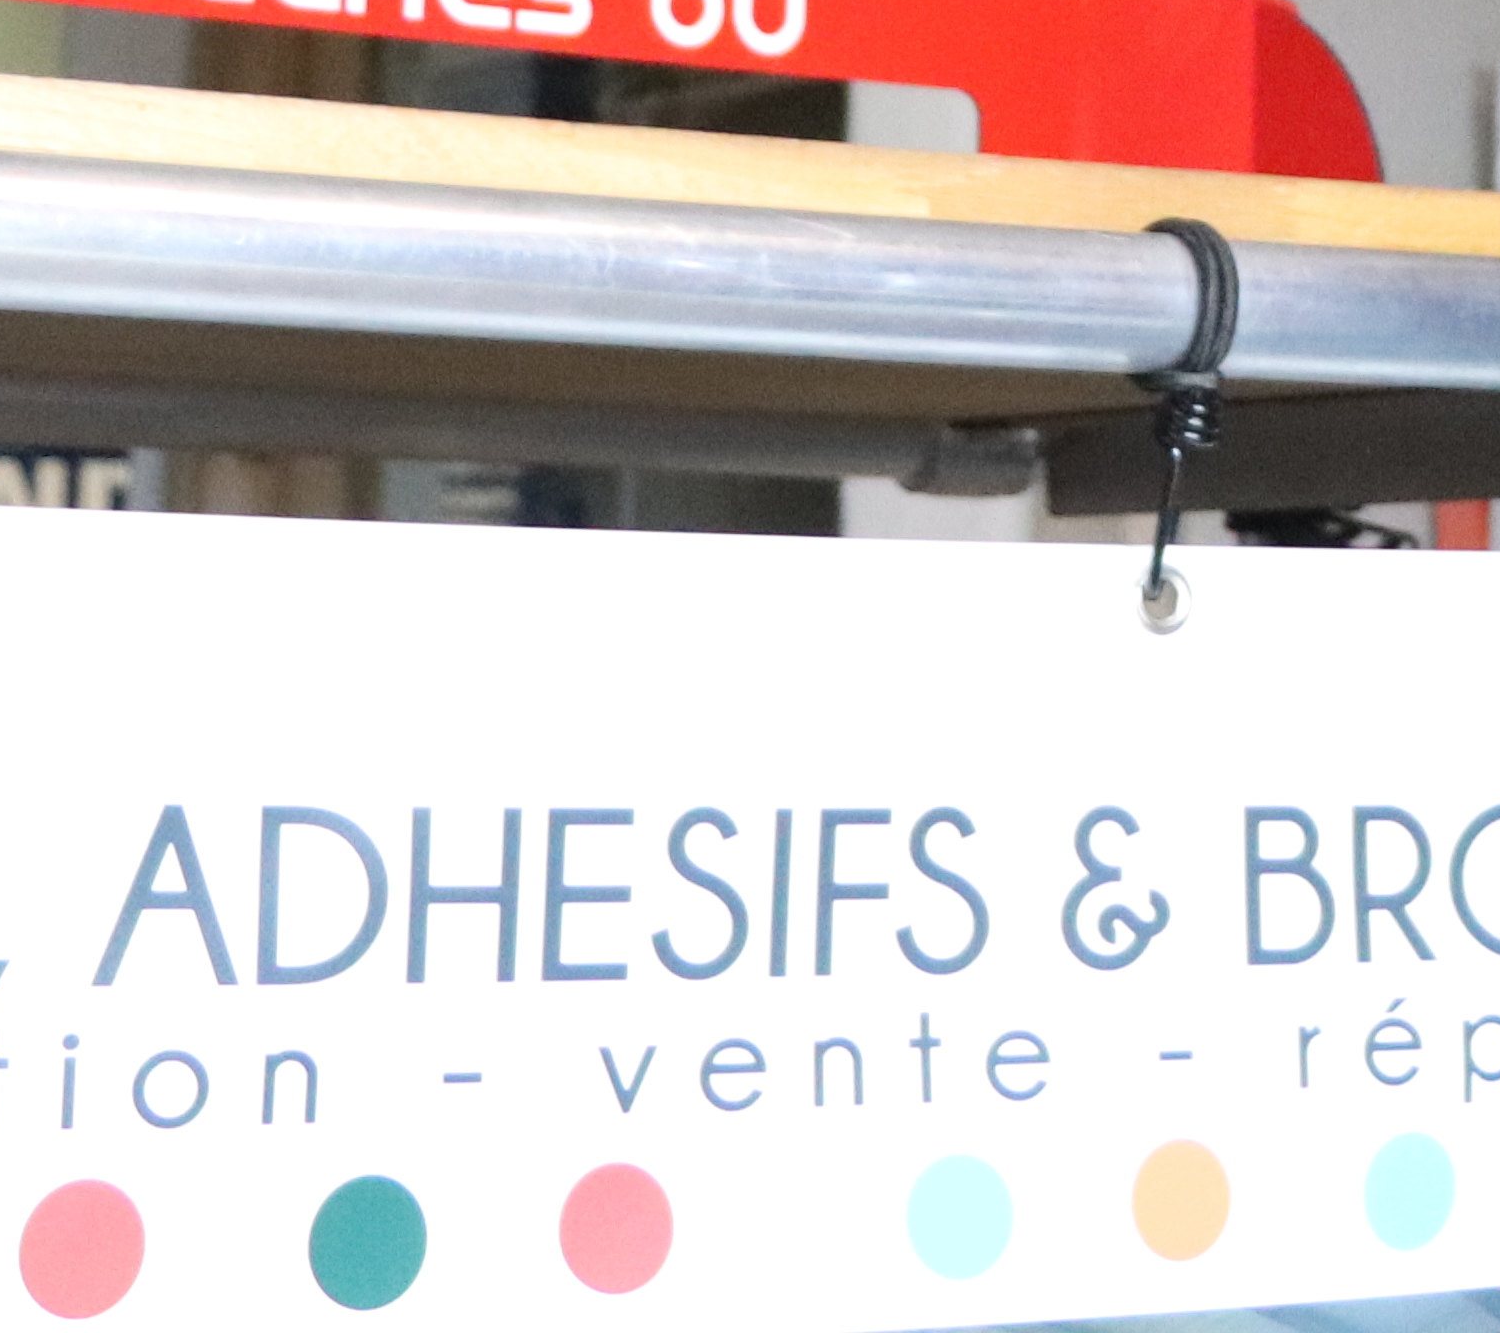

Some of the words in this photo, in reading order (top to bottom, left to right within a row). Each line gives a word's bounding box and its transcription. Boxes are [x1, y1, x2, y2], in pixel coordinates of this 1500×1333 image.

[90, 803, 990, 988] ADHESIFS
[1060, 804, 1172, 971] &
[599, 1011, 1052, 1114] vente
